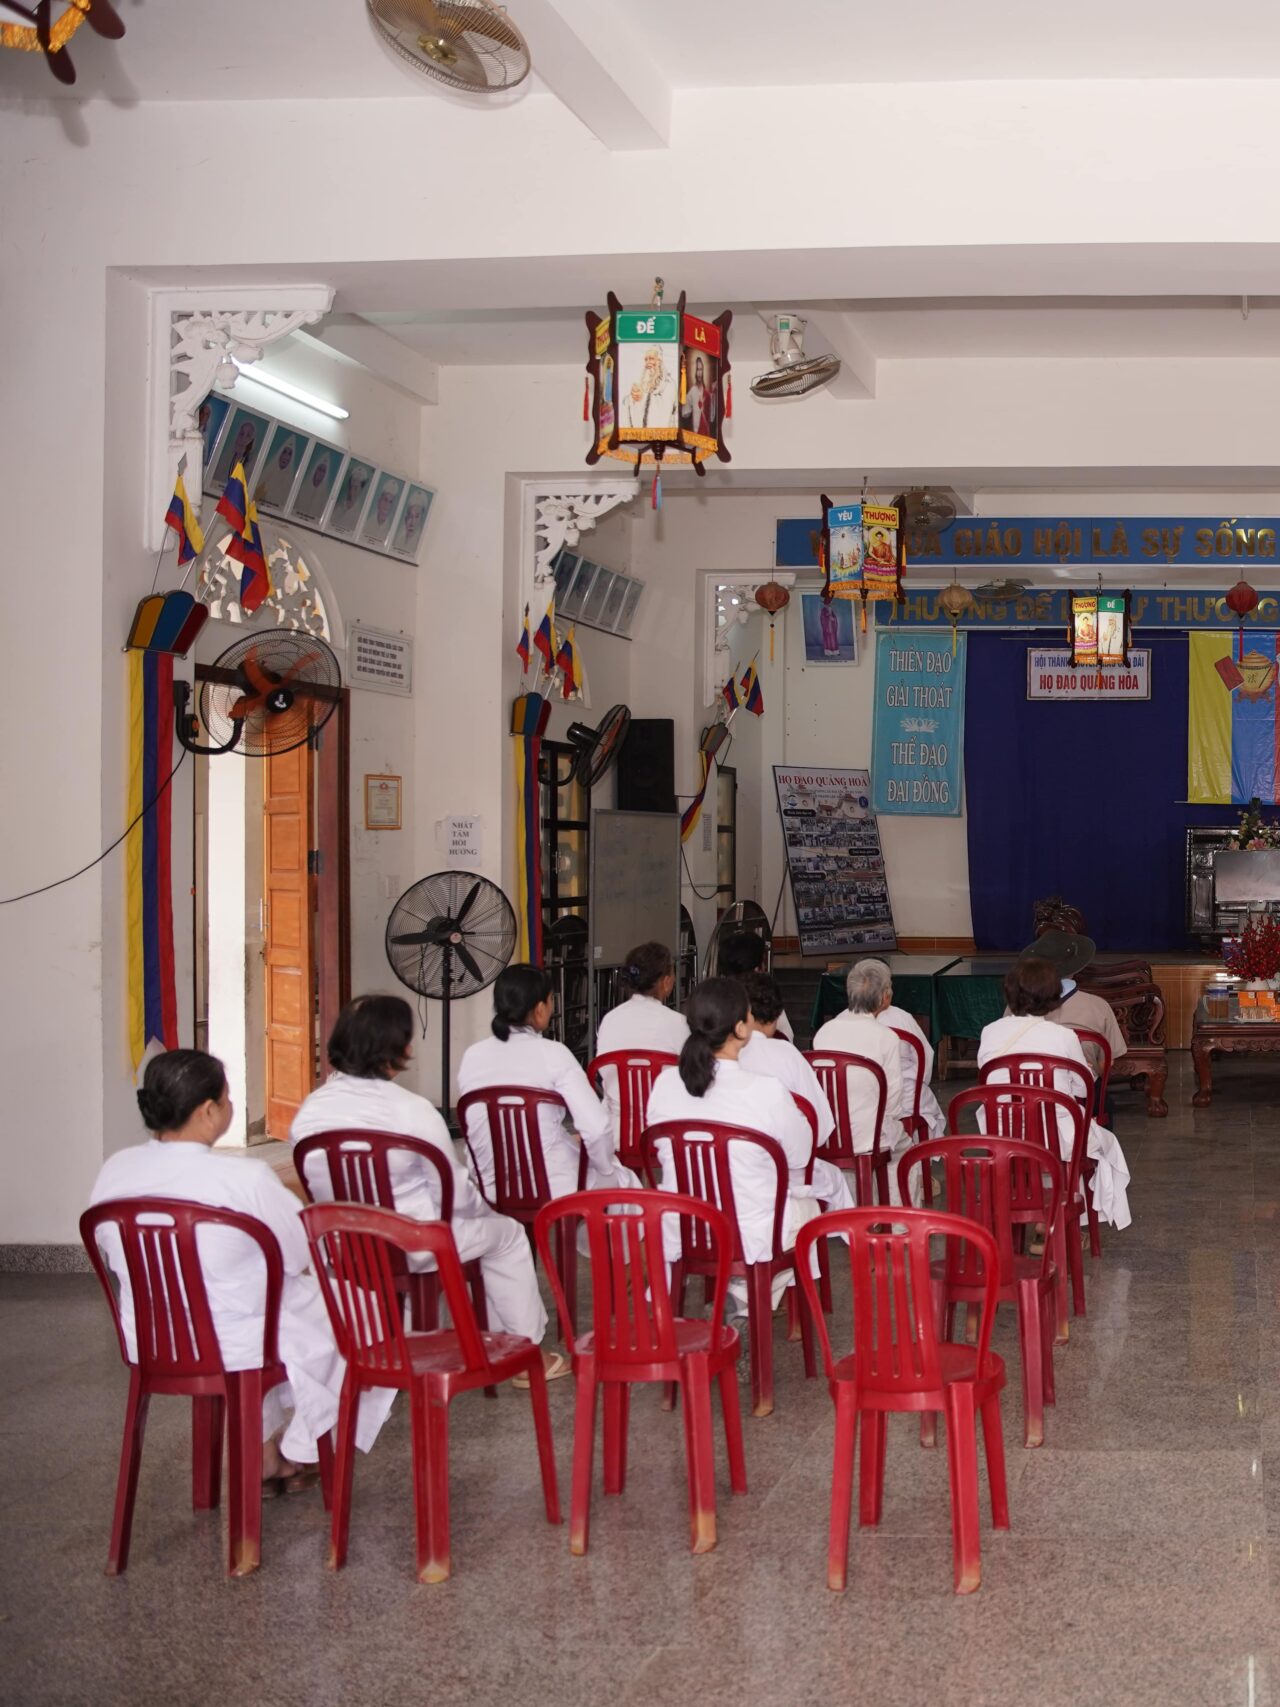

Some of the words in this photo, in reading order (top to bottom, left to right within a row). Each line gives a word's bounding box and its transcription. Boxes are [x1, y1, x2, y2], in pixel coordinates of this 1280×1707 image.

[636, 316, 657, 334] ĐẾ
[694, 327, 707, 344] LÀ
[837, 511, 853, 521] YÊU
[954, 521, 1022, 558] GIÁO
[1031, 521, 1082, 563] HỘI
[1092, 521, 1129, 558] LÀ
[1141, 526, 1183, 564] SỰ
[889, 646, 924, 672] THIÊN
[926, 650, 952, 676] ĐẠO
[1034, 654, 1046, 670] HỘI
[913, 681, 953, 709] THOÁT
[1039, 674, 1053, 694] HỌ
[1056, 674, 1077, 694] ĐẠO
[1118, 671, 1139, 690] HÒA
[891, 735, 916, 765] THẾ
[919, 743, 948, 769] ĐẠO
[887, 779, 909, 805] ĐẠI
[912, 774, 949, 804] ĐỒNG
